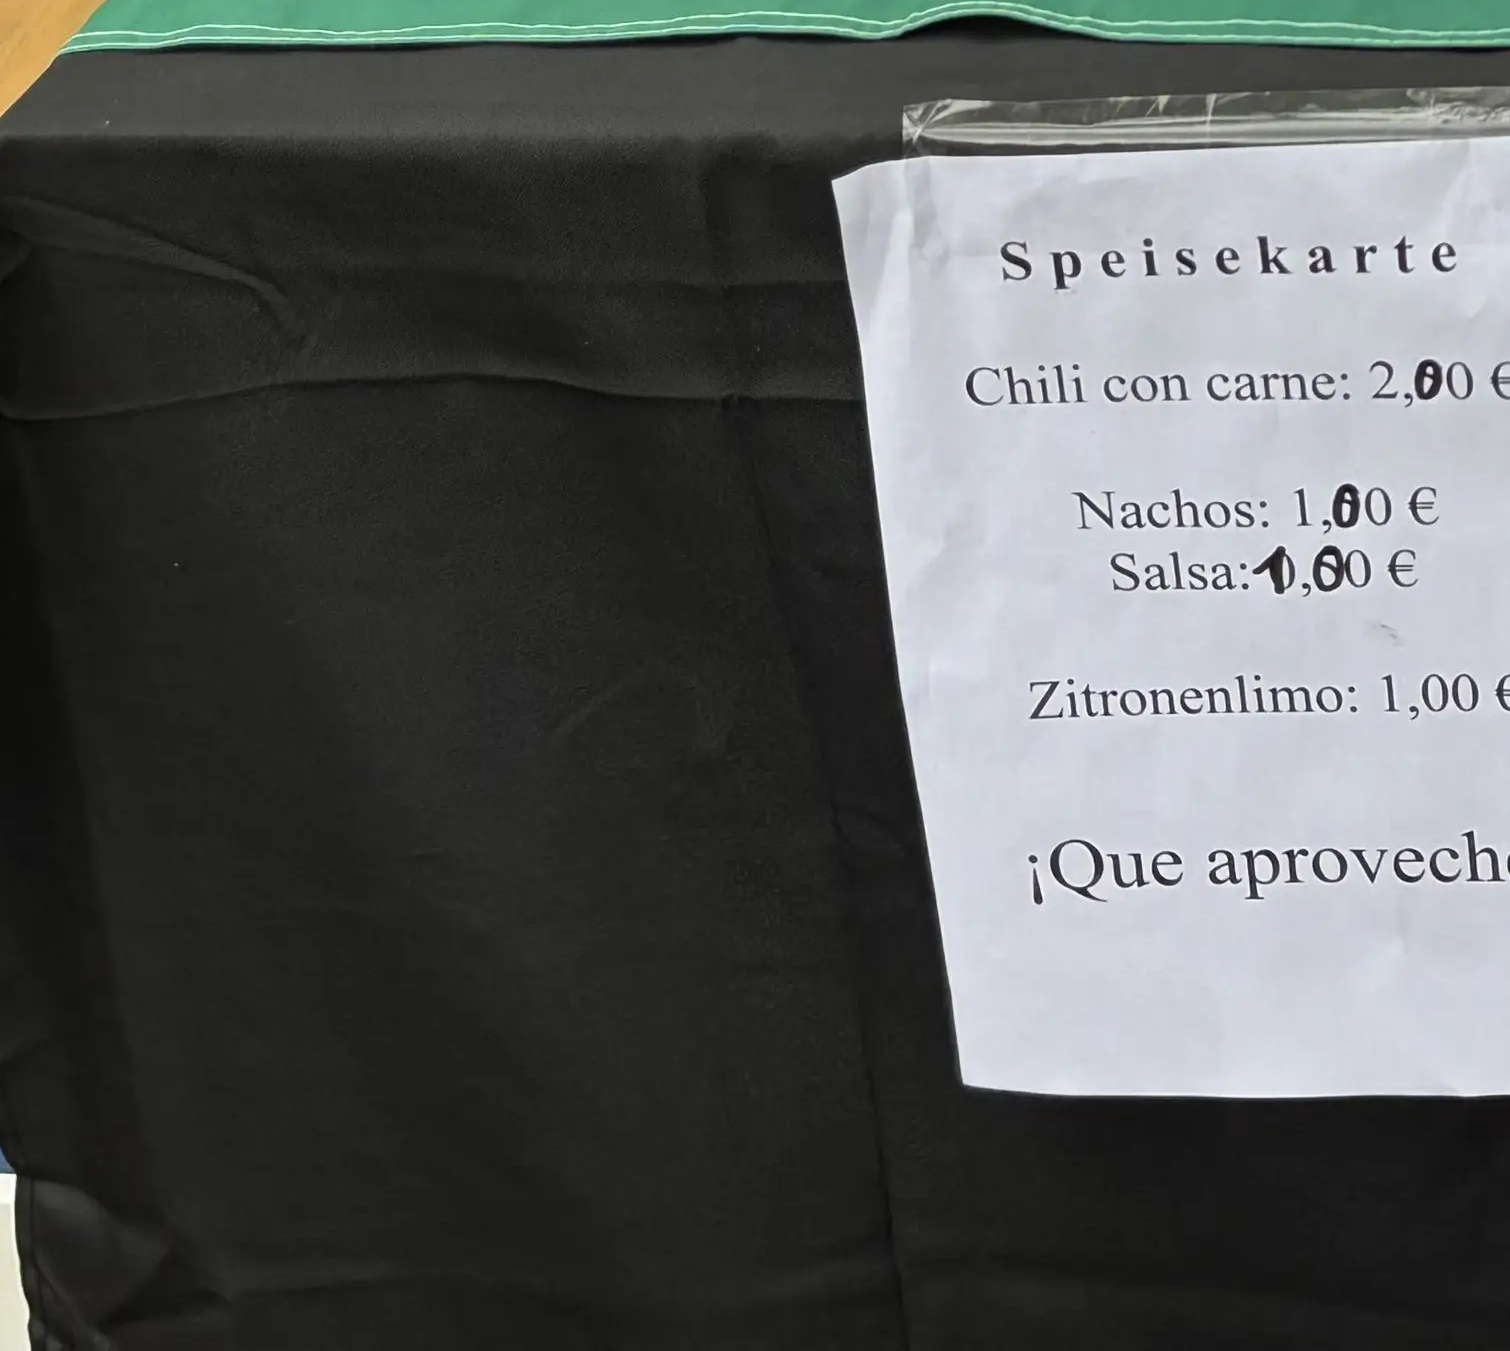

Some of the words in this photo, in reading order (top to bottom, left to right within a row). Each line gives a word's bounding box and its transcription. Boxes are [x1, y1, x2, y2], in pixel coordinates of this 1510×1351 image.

[1000, 234, 1458, 291] Speisekarte
[965, 363, 1088, 407] Chili
[1102, 371, 1192, 403] con
[1206, 366, 1352, 403] carne:
[1368, 358, 1475, 410] 2,00
[1071, 487, 1270, 531] Nachos:
[1293, 483, 1393, 534] 1,00
[1408, 486, 1441, 527] €
[1110, 551, 1250, 593] Salsa:
[1387, 549, 1420, 589] €
[1028, 675, 1359, 720] Zitronenlimo:
[1381, 673, 1481, 720] 1,00
[1027, 838, 1184, 905] ¡Que
